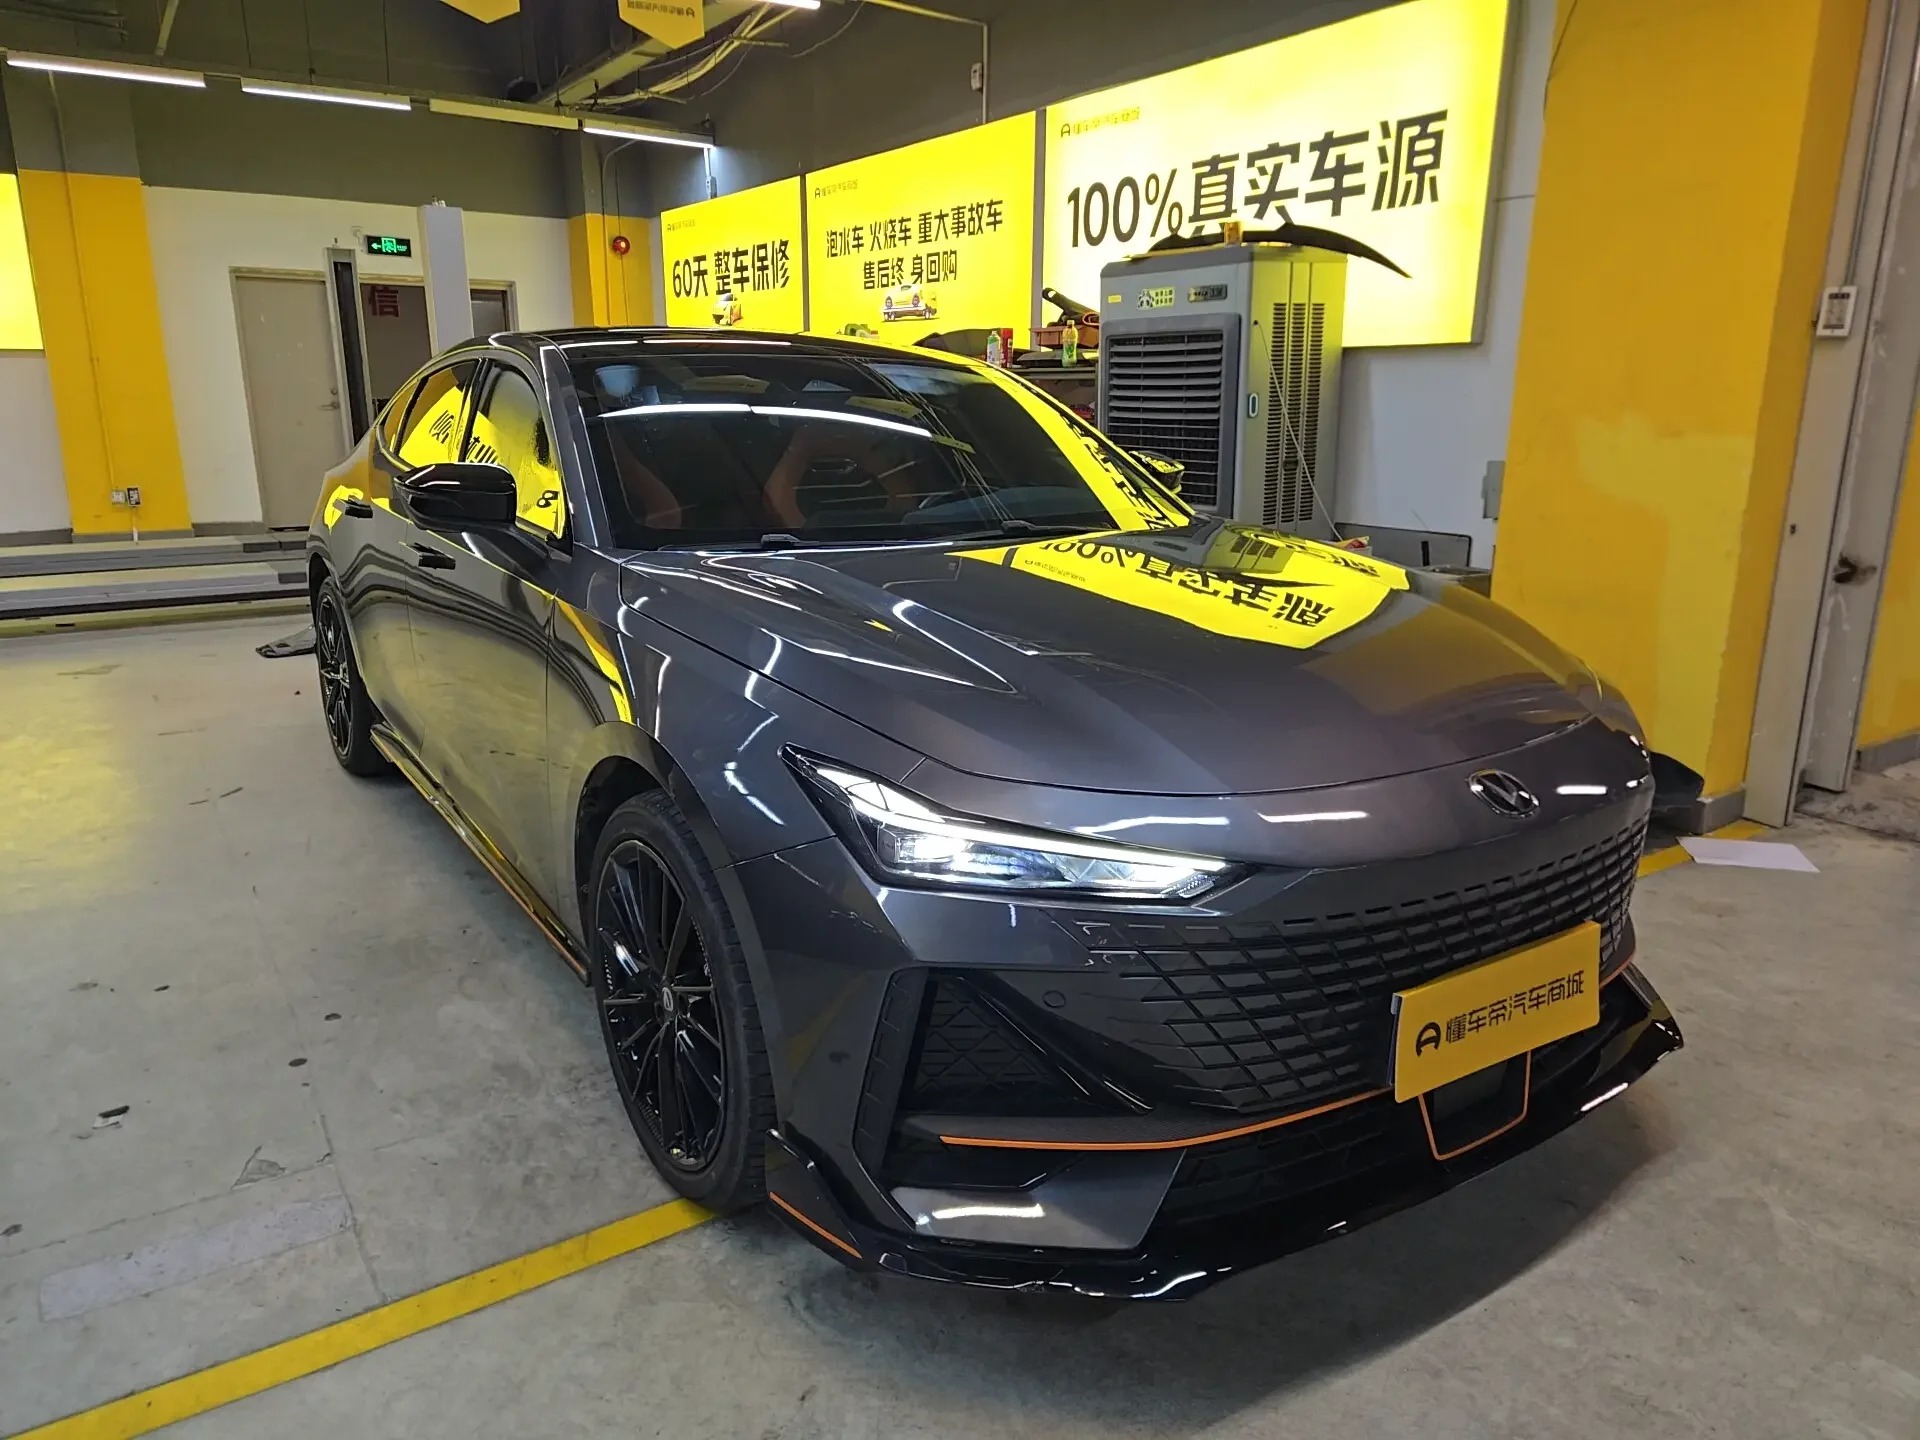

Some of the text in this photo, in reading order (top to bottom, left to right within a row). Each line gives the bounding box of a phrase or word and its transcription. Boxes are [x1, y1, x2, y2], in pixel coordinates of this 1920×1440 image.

[826, 198, 1003, 258] 泡水车 火烧车 重大事故车
[672, 238, 790, 298] 60天 整车保修
[369, 286, 400, 317] 信
[1445, 969, 1584, 1044] 懂车帝汽车商城
